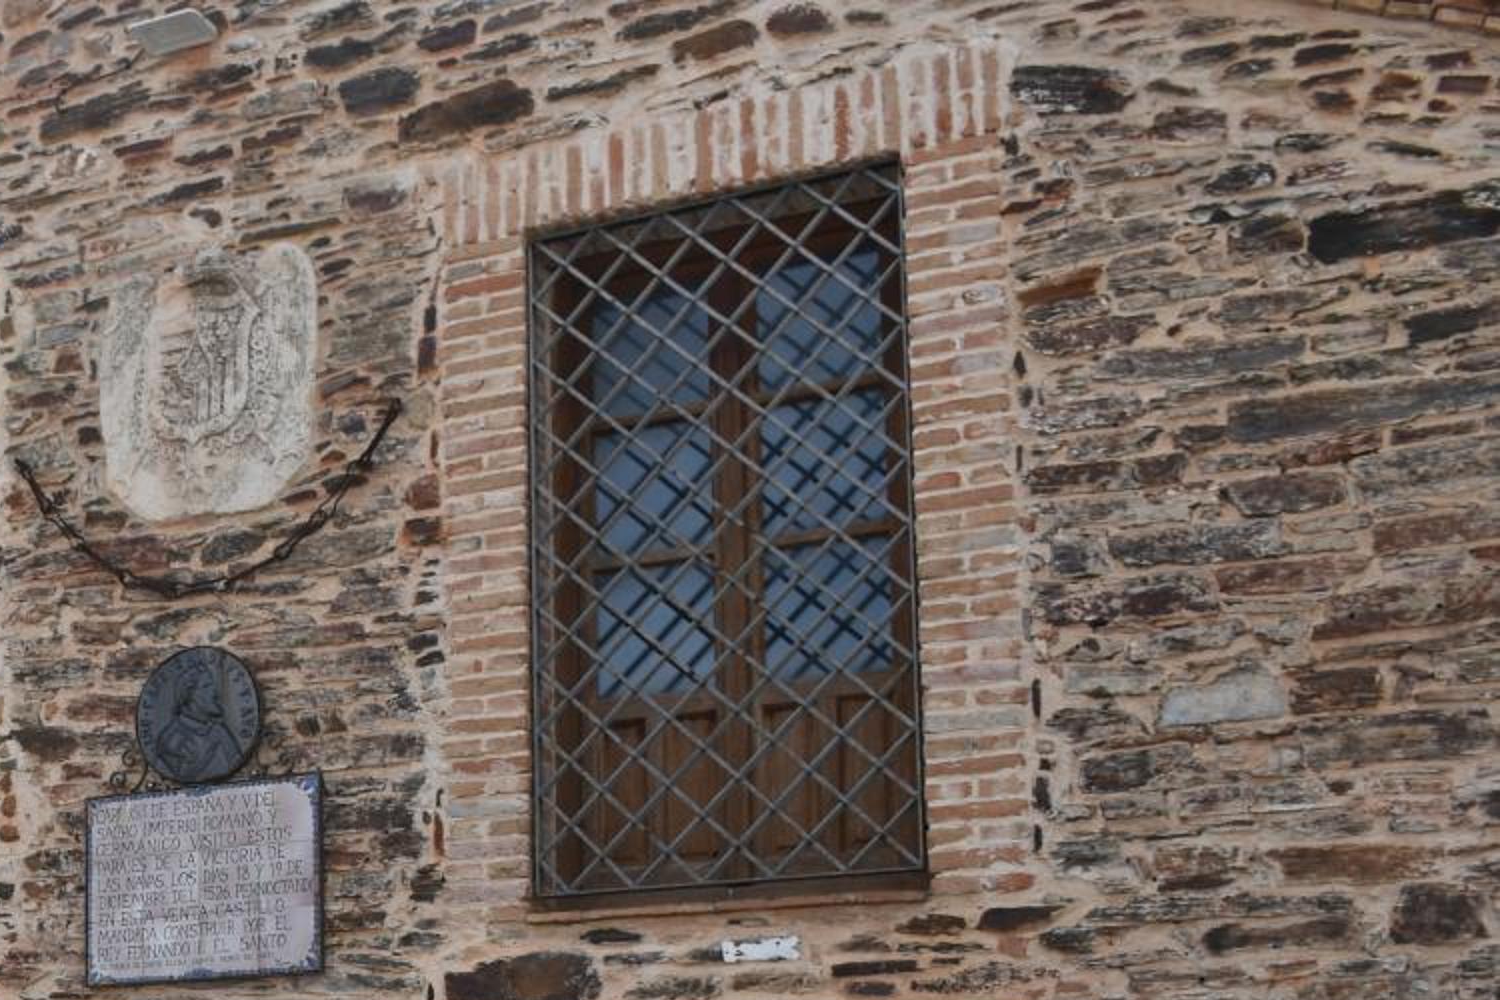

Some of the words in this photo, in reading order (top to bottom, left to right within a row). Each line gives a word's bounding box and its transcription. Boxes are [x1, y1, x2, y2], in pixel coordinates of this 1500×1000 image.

[227, 795, 237, 811] Y
[143, 817, 196, 837] IMPERIO
[203, 809, 263, 832] ROMANO
[266, 808, 277, 824] Y
[155, 854, 171, 871] DE
[179, 851, 196, 869] LA
[201, 847, 263, 867] VICTORIA
[267, 842, 285, 860] DE
[98, 876, 121, 893] LAS
[172, 869, 197, 888] LOS
[237, 863, 250, 880] 18
[254, 863, 263, 880] Y
[287, 858, 303, 876] DE
[275, 914, 292, 932] EL
